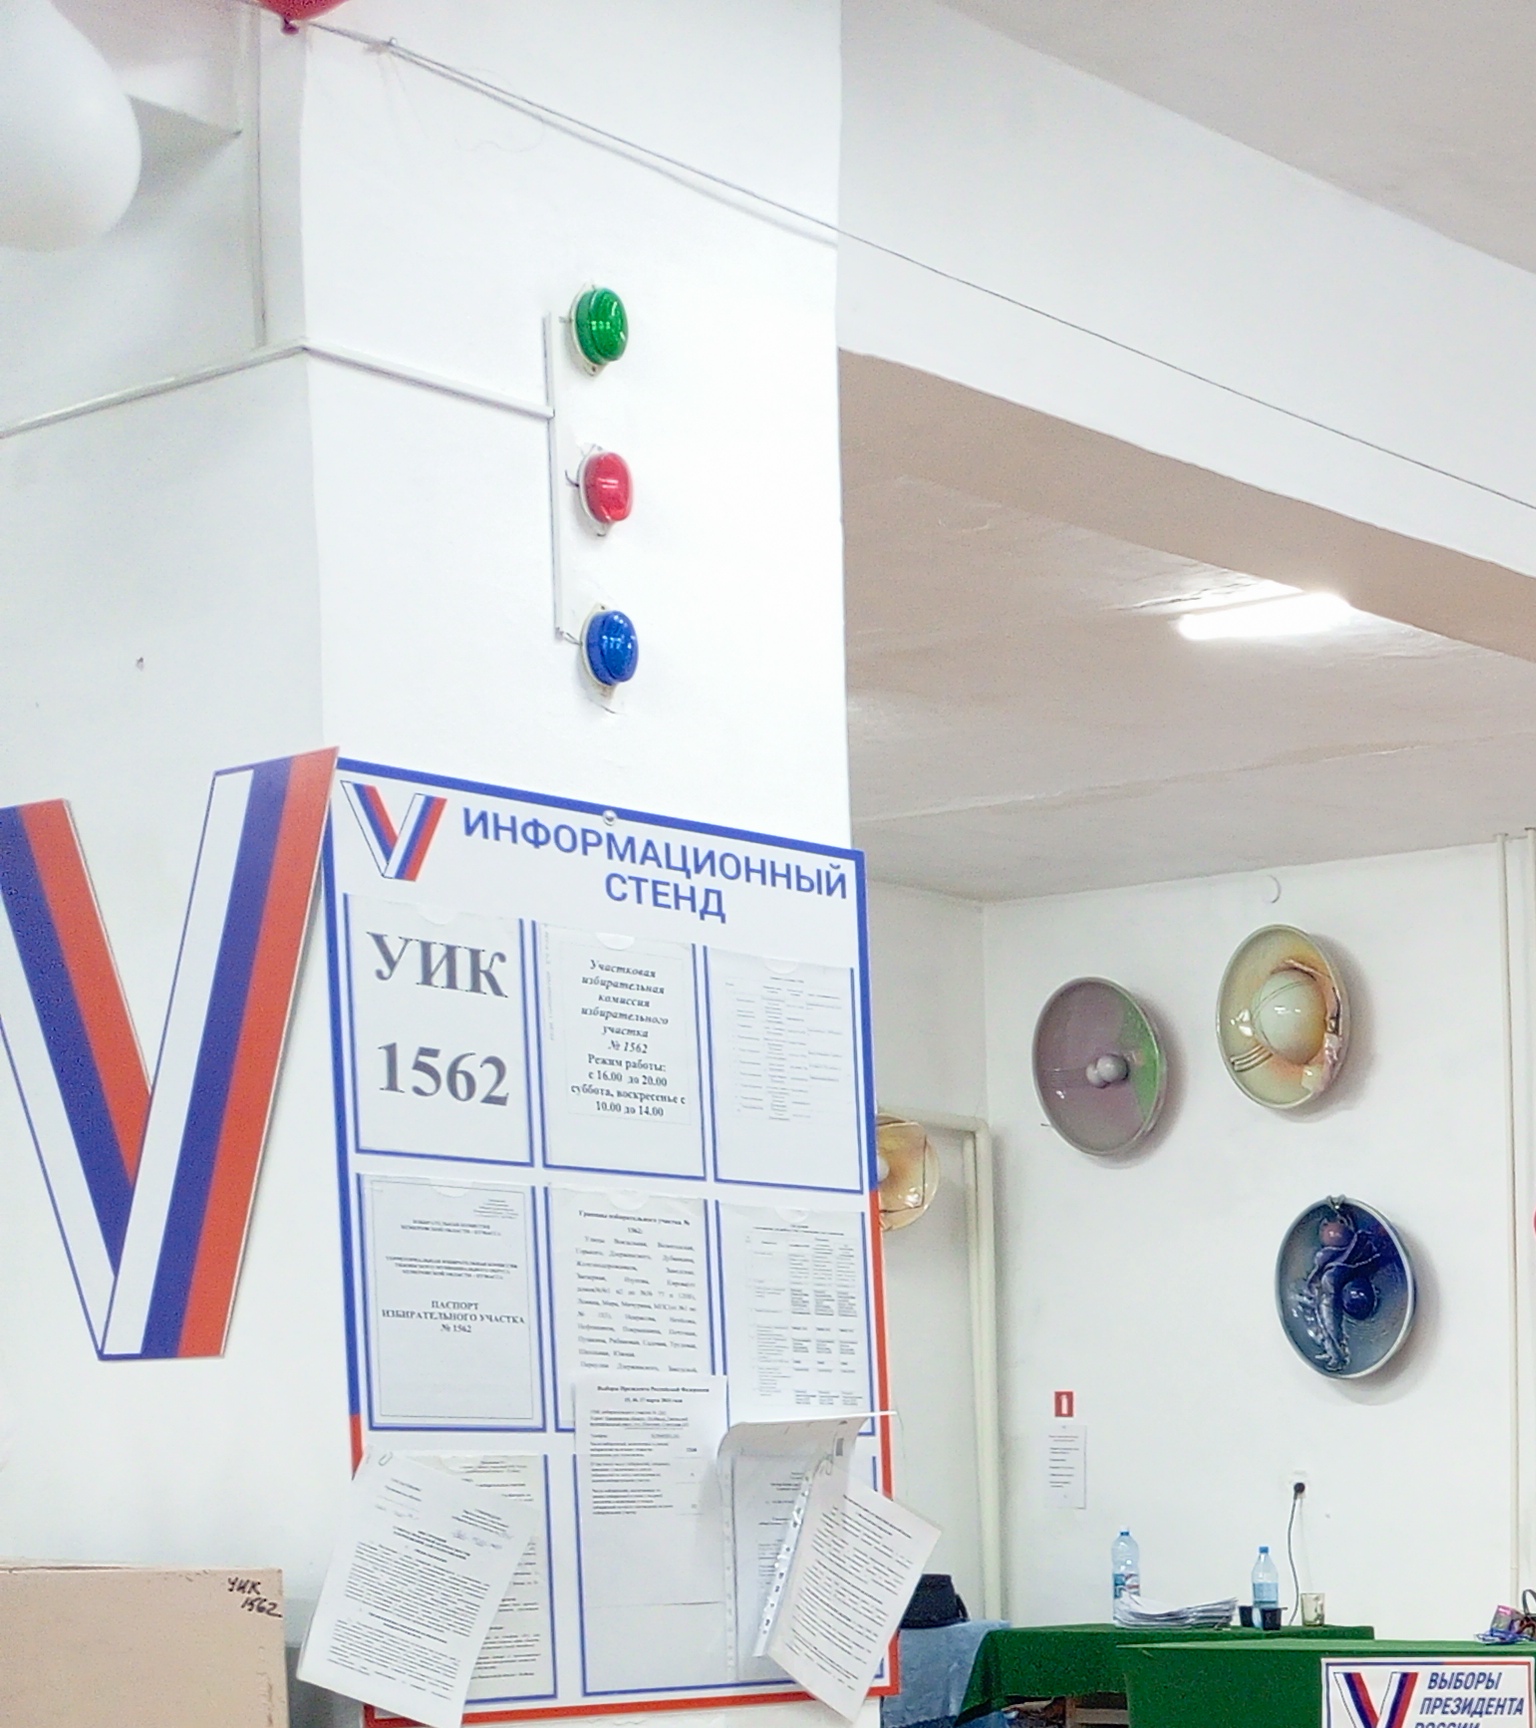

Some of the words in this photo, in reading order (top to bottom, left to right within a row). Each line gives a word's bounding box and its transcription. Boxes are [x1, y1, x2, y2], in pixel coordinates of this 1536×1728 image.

[462, 807, 848, 899] ИНФОРМАЦИОННЫЙ
[605, 873, 726, 923] СТЕНД
[366, 932, 508, 998] УИК
[624, 1041, 648, 1053] 1562
[588, 1054, 622, 1067] Режим
[377, 1041, 510, 1107] 1562
[597, 1071, 622, 1082] 16.00
[642, 1075, 667, 1086] 20.00
[596, 1101, 621, 1112] 10.00
[639, 1105, 664, 1116] 14.00
[227, 1577, 261, 1595] УИК
[240, 1597, 283, 1618] 1562
[1428, 1672, 1502, 1690] ВЫБОРЫ
[1420, 1698, 1524, 1718] ПРЕЗИДЕНТА
